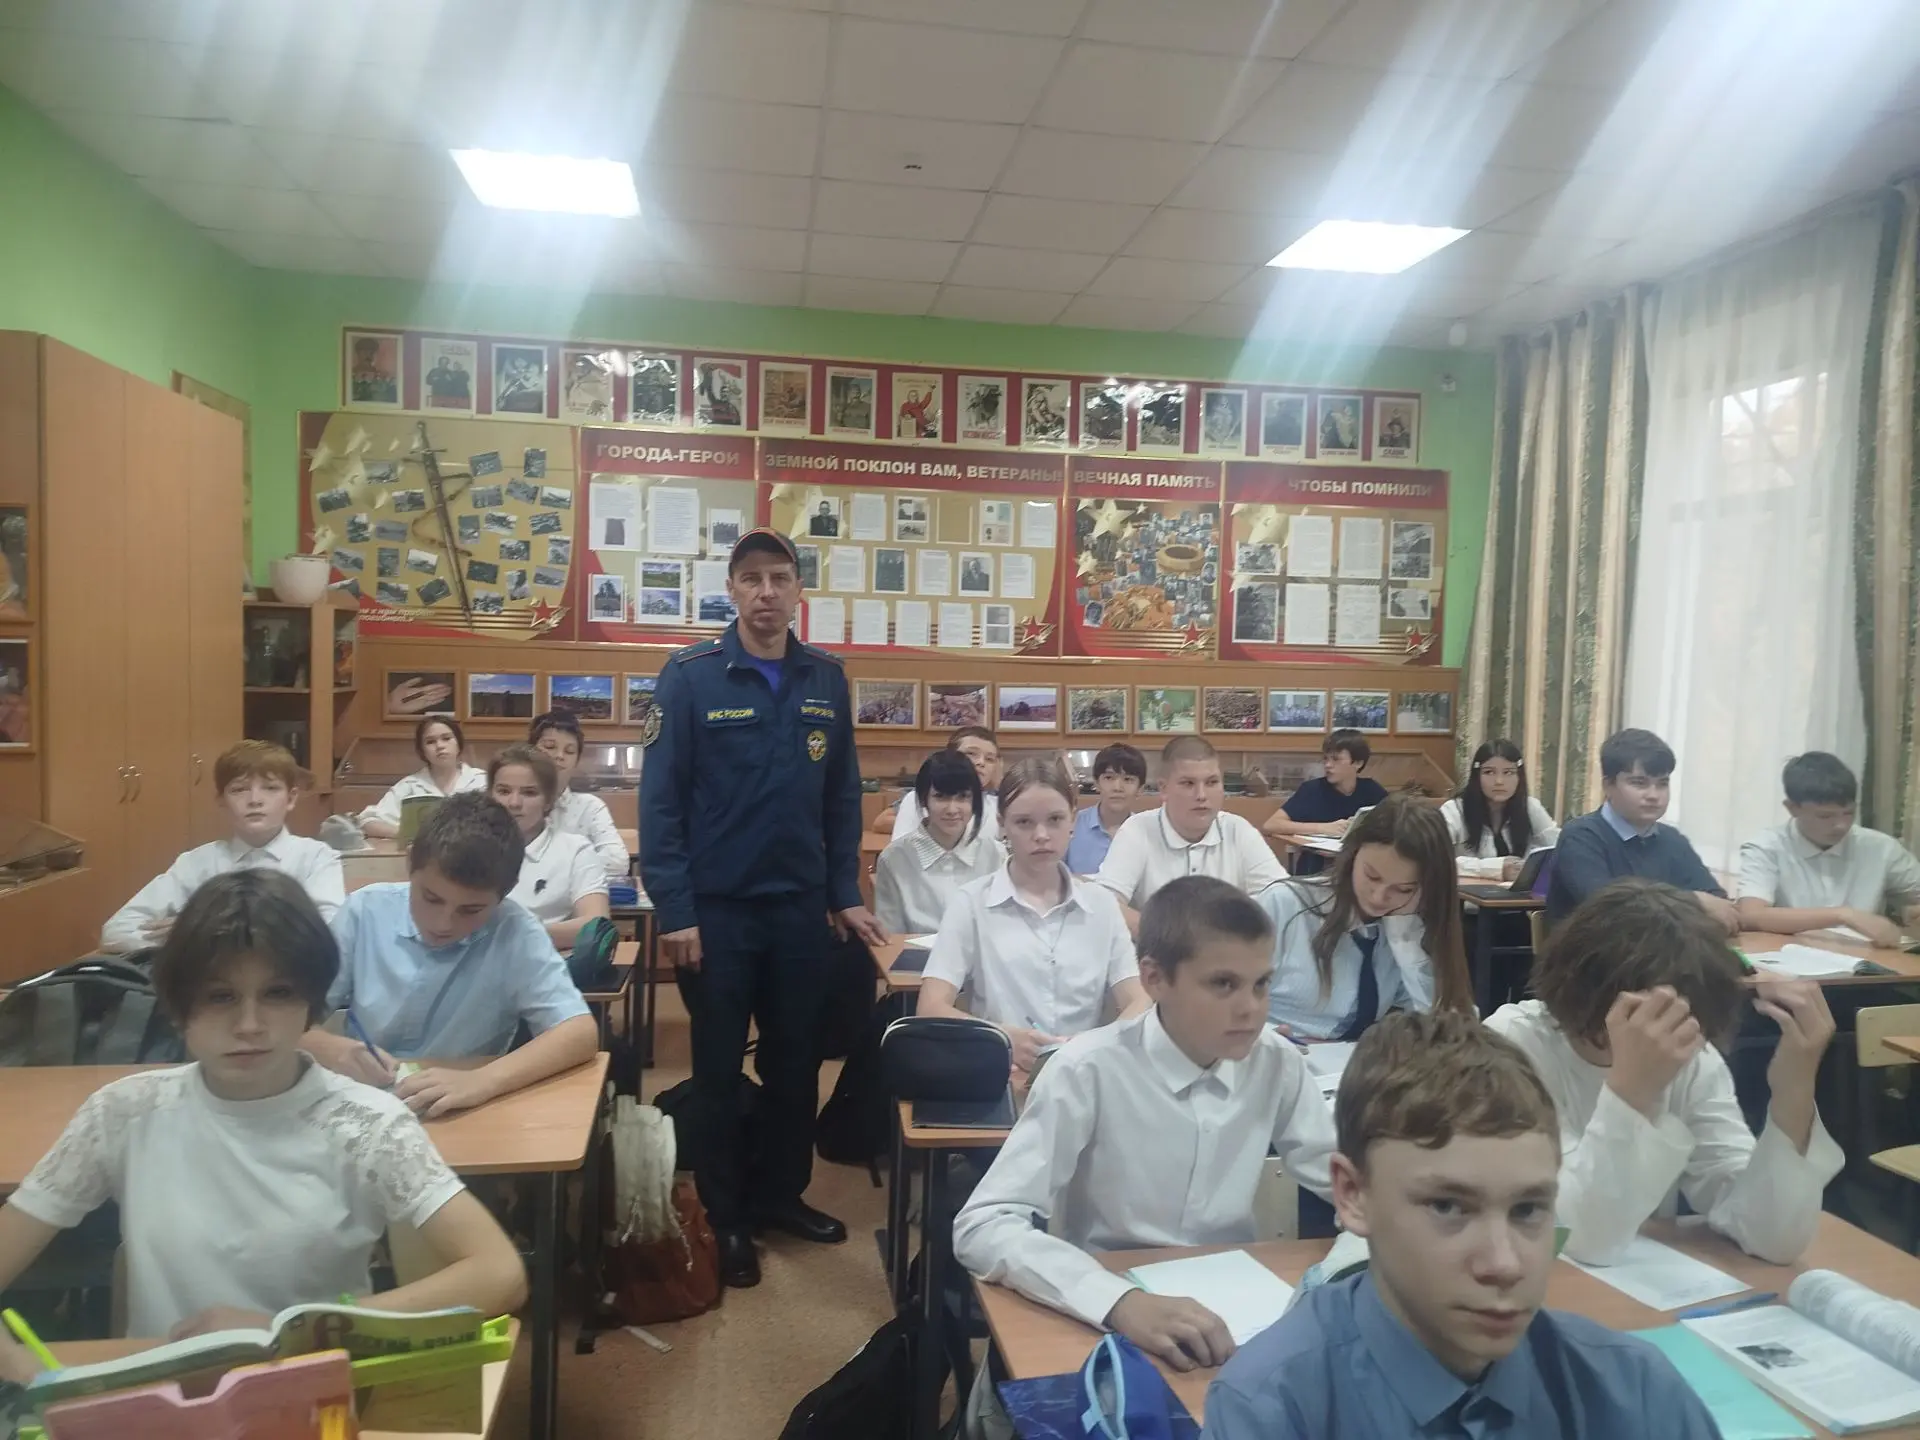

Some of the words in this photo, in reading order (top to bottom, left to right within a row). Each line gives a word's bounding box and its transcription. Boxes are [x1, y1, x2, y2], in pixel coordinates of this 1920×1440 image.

[597, 444, 740, 465] ГОРОДА-ГЕРОИ
[765, 453, 838, 471] ЗЕМНОЙ
[844, 458, 915, 475] ПОКЛОН
[920, 463, 962, 480] ВАМ,
[1074, 470, 1142, 486] ВЕЧНАЯ
[1146, 473, 1216, 489] ПАМЯТЬ
[1289, 479, 1347, 493] ЧТОБЫ
[1351, 481, 1433, 497] ПОМНИЛИ
